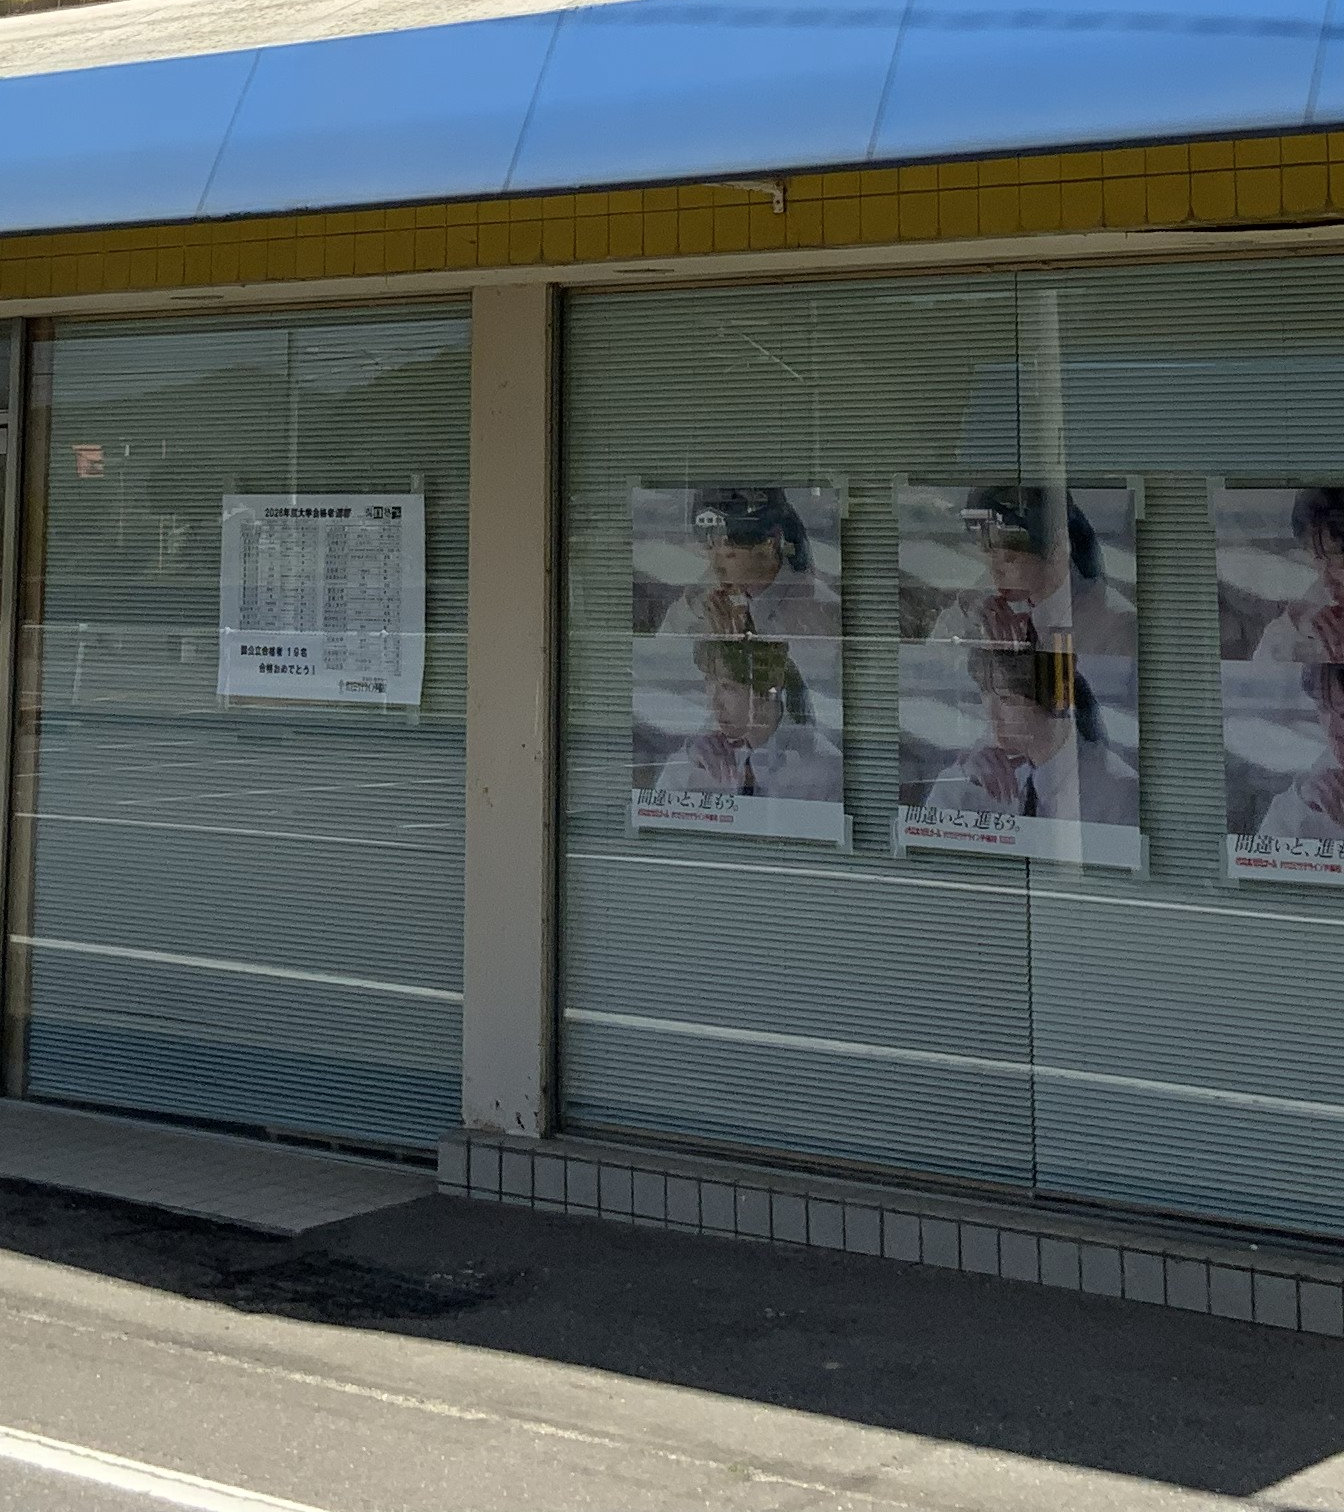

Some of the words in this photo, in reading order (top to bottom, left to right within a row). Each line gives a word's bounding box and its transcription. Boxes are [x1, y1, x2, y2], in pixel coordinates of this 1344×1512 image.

[637, 788, 739, 812] 間違いと、進もう。
[905, 806, 1020, 832] 間違いと、進もう。
